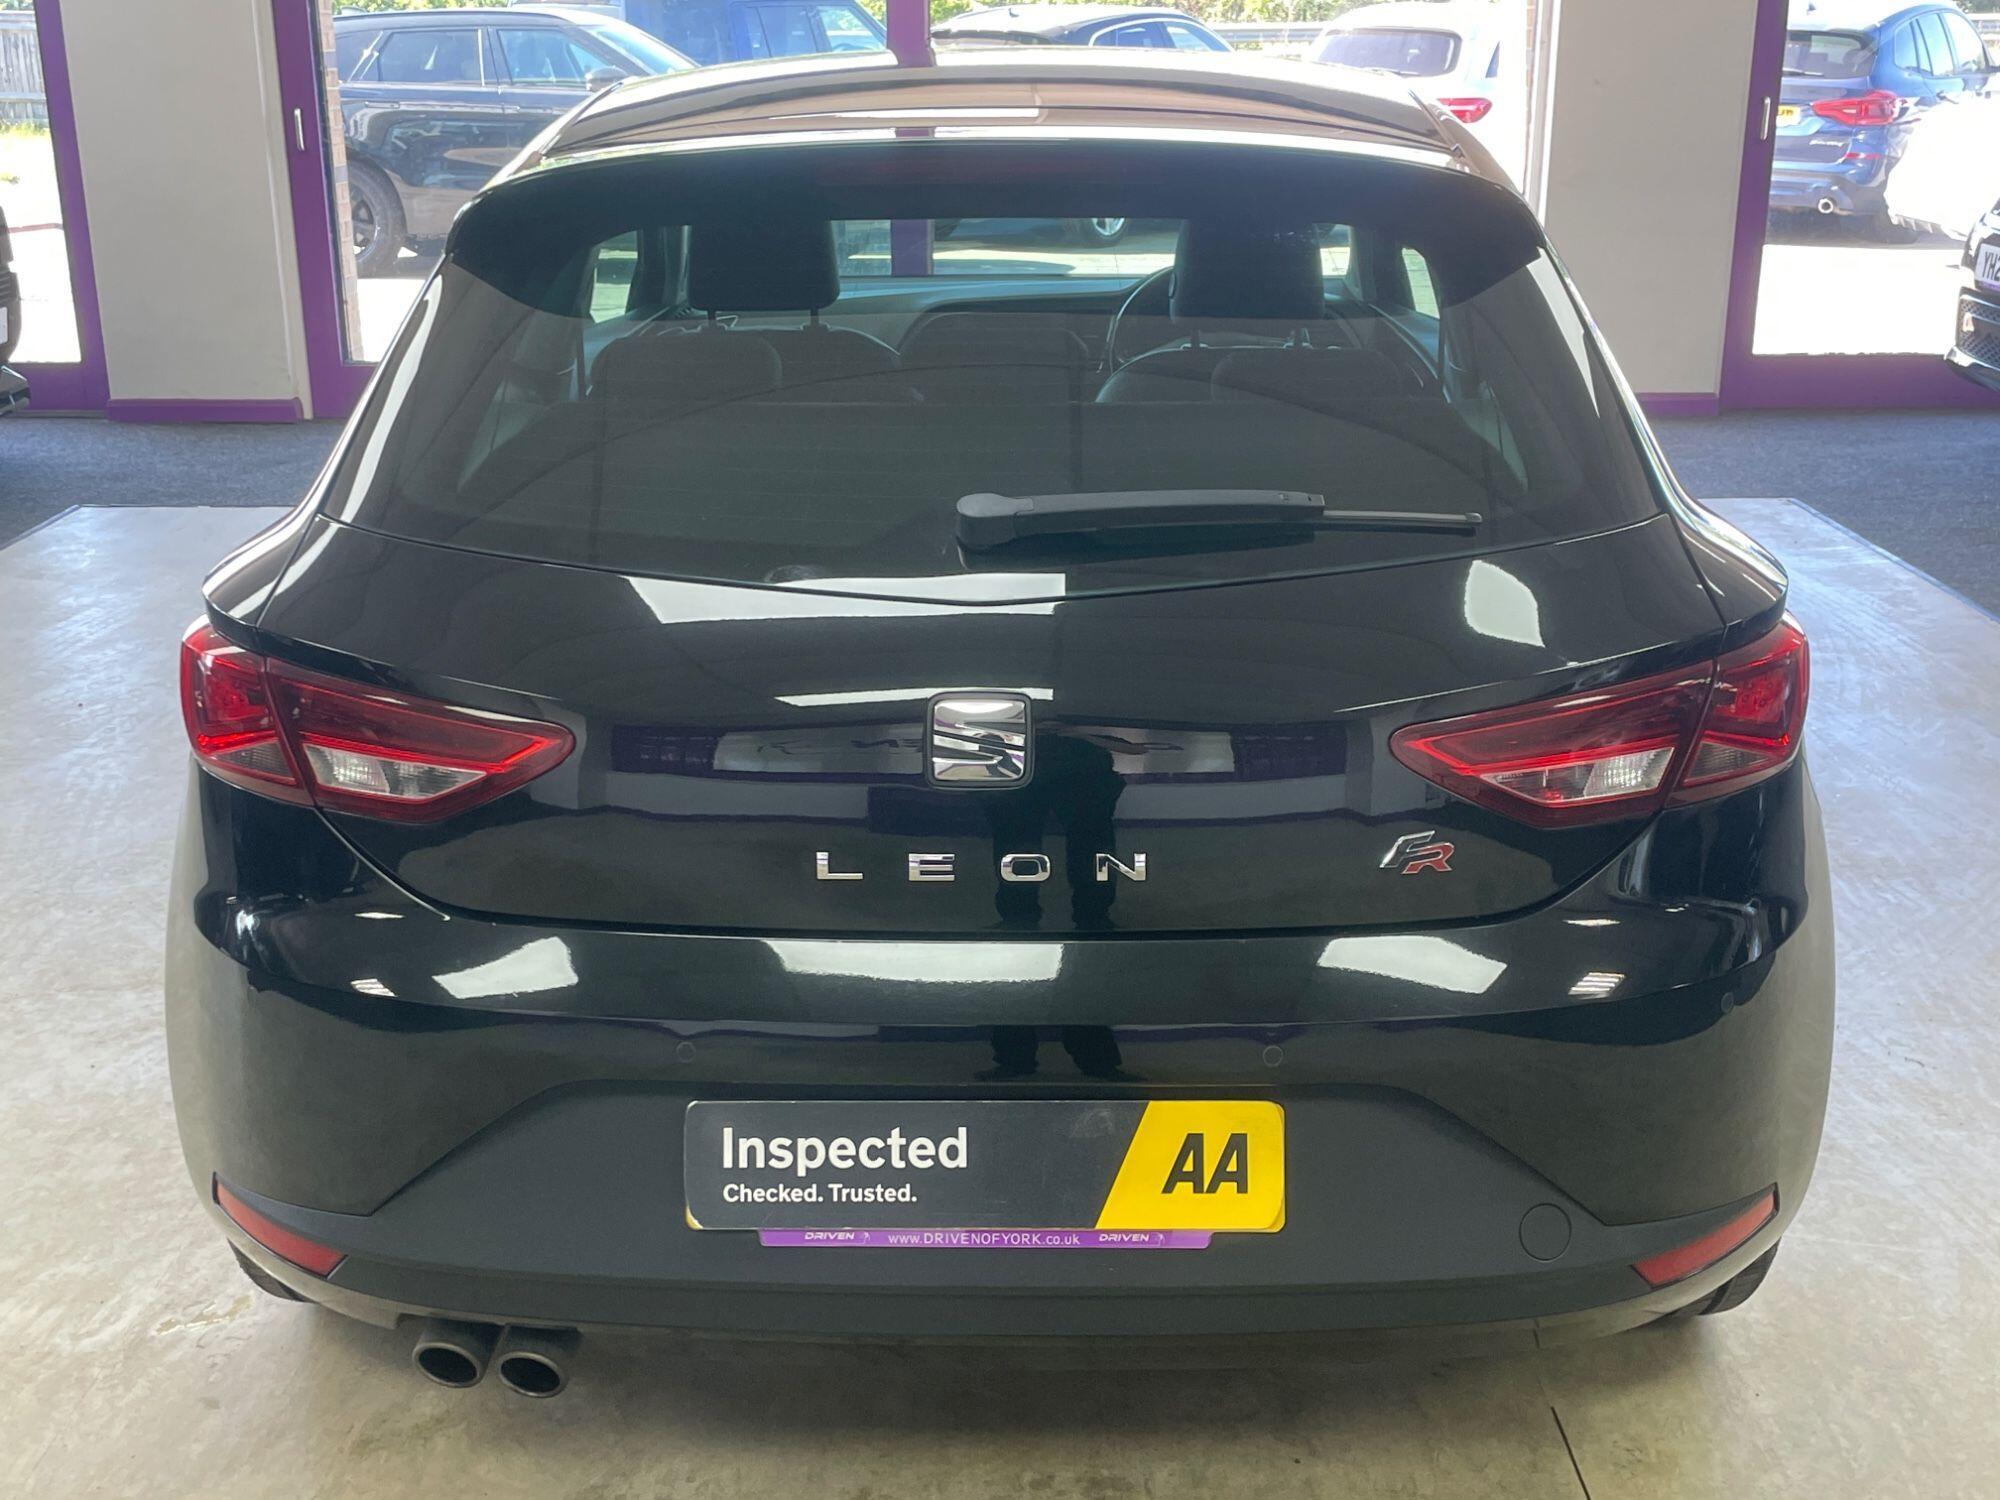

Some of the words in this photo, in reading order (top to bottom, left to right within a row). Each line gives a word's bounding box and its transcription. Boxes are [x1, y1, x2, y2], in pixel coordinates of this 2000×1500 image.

[816, 852, 1146, 882] LEON
[1380, 831, 1453, 874] FR
[723, 1127, 967, 1176] Inspected
[1163, 1133, 1248, 1194] AA
[723, 1184, 822, 1203] Checked.
[828, 1184, 917, 1203] Trusted.
[804, 1231, 855, 1240] DRIVEN
[888, 1232, 1080, 1245] www.DRIVENOFYORK.co.uk
[1099, 1233, 1150, 1242] DRIVEN
